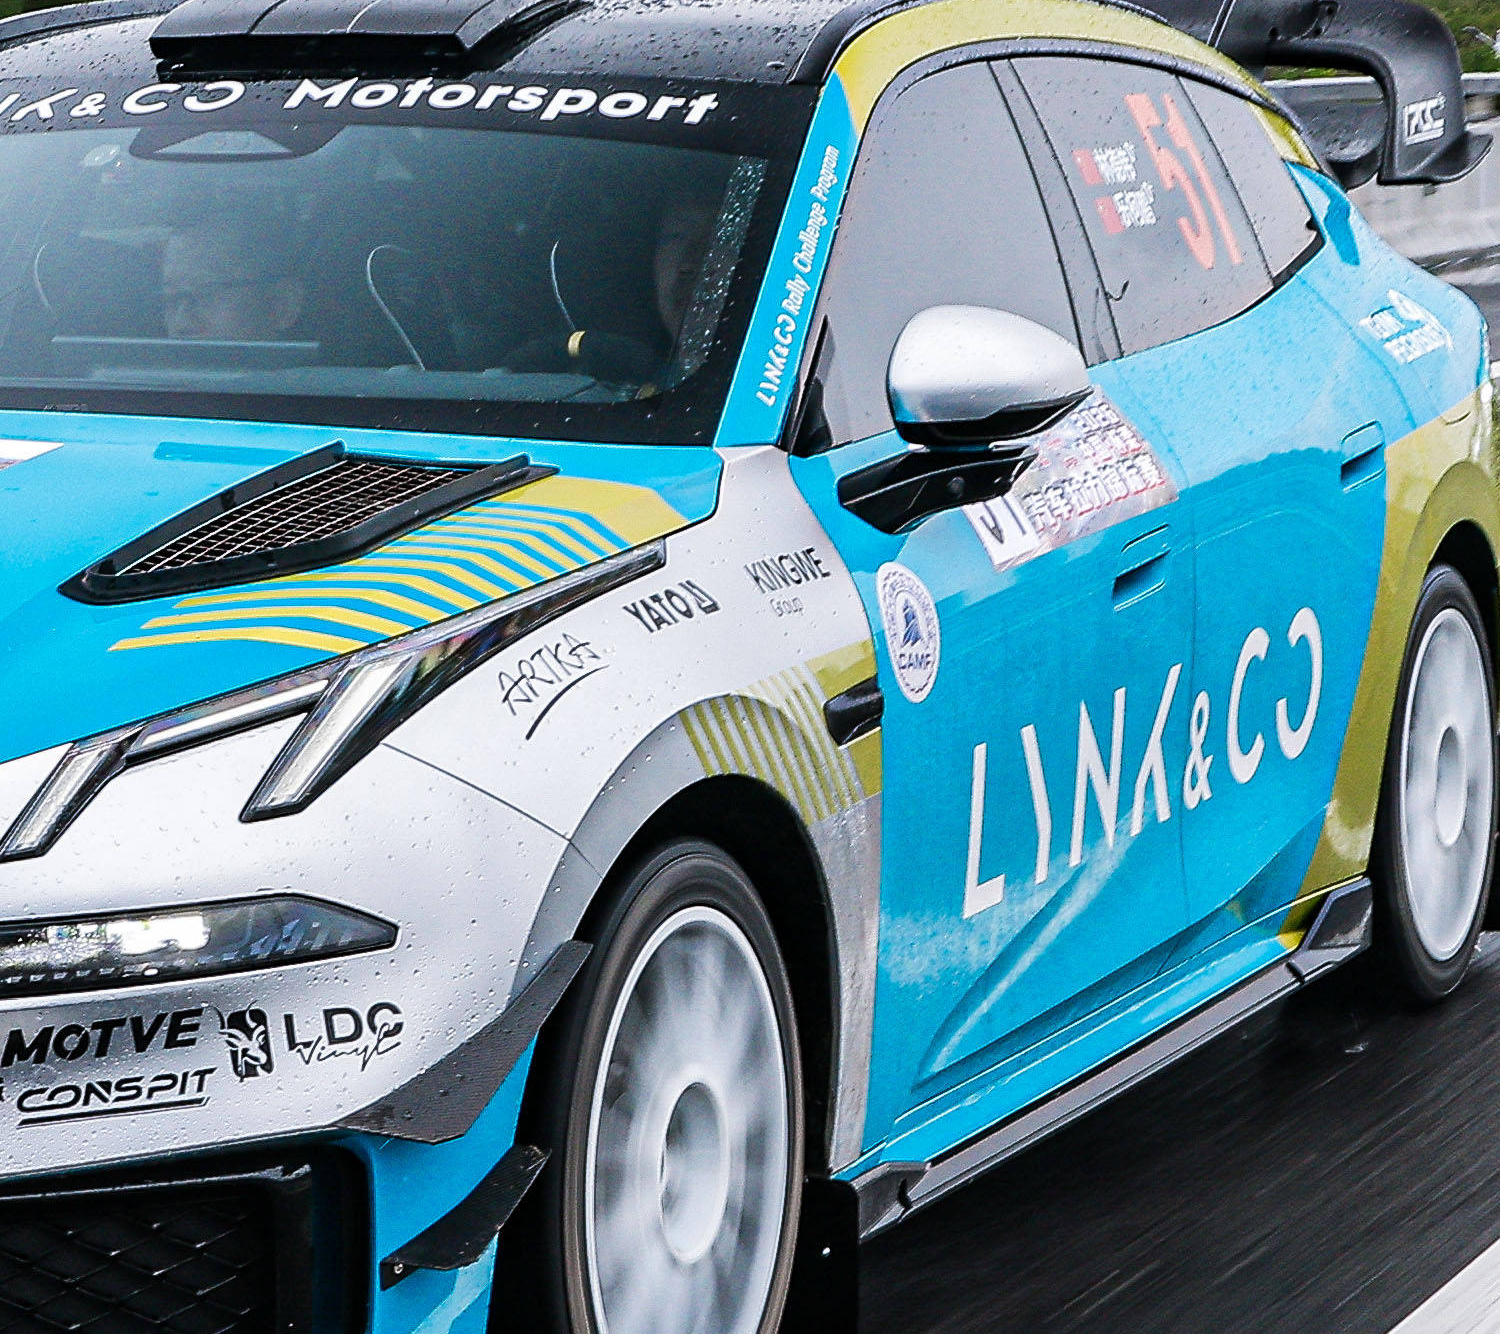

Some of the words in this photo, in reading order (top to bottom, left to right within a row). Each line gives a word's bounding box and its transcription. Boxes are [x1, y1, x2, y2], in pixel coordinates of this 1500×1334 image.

[282, 77, 719, 125] Motorsport
[810, 144, 840, 202] Program
[1123, 93, 1244, 271] 51
[792, 202, 829, 275] Challenge
[782, 274, 811, 317] Rally
[744, 547, 831, 595] KINGWE
[622, 589, 694, 634] YATO
[769, 595, 805, 618] Group
[0, 1007, 208, 1068] MOTVE
[284, 1000, 405, 1053] LDC
[16, 1067, 218, 1113] CONSPIT
